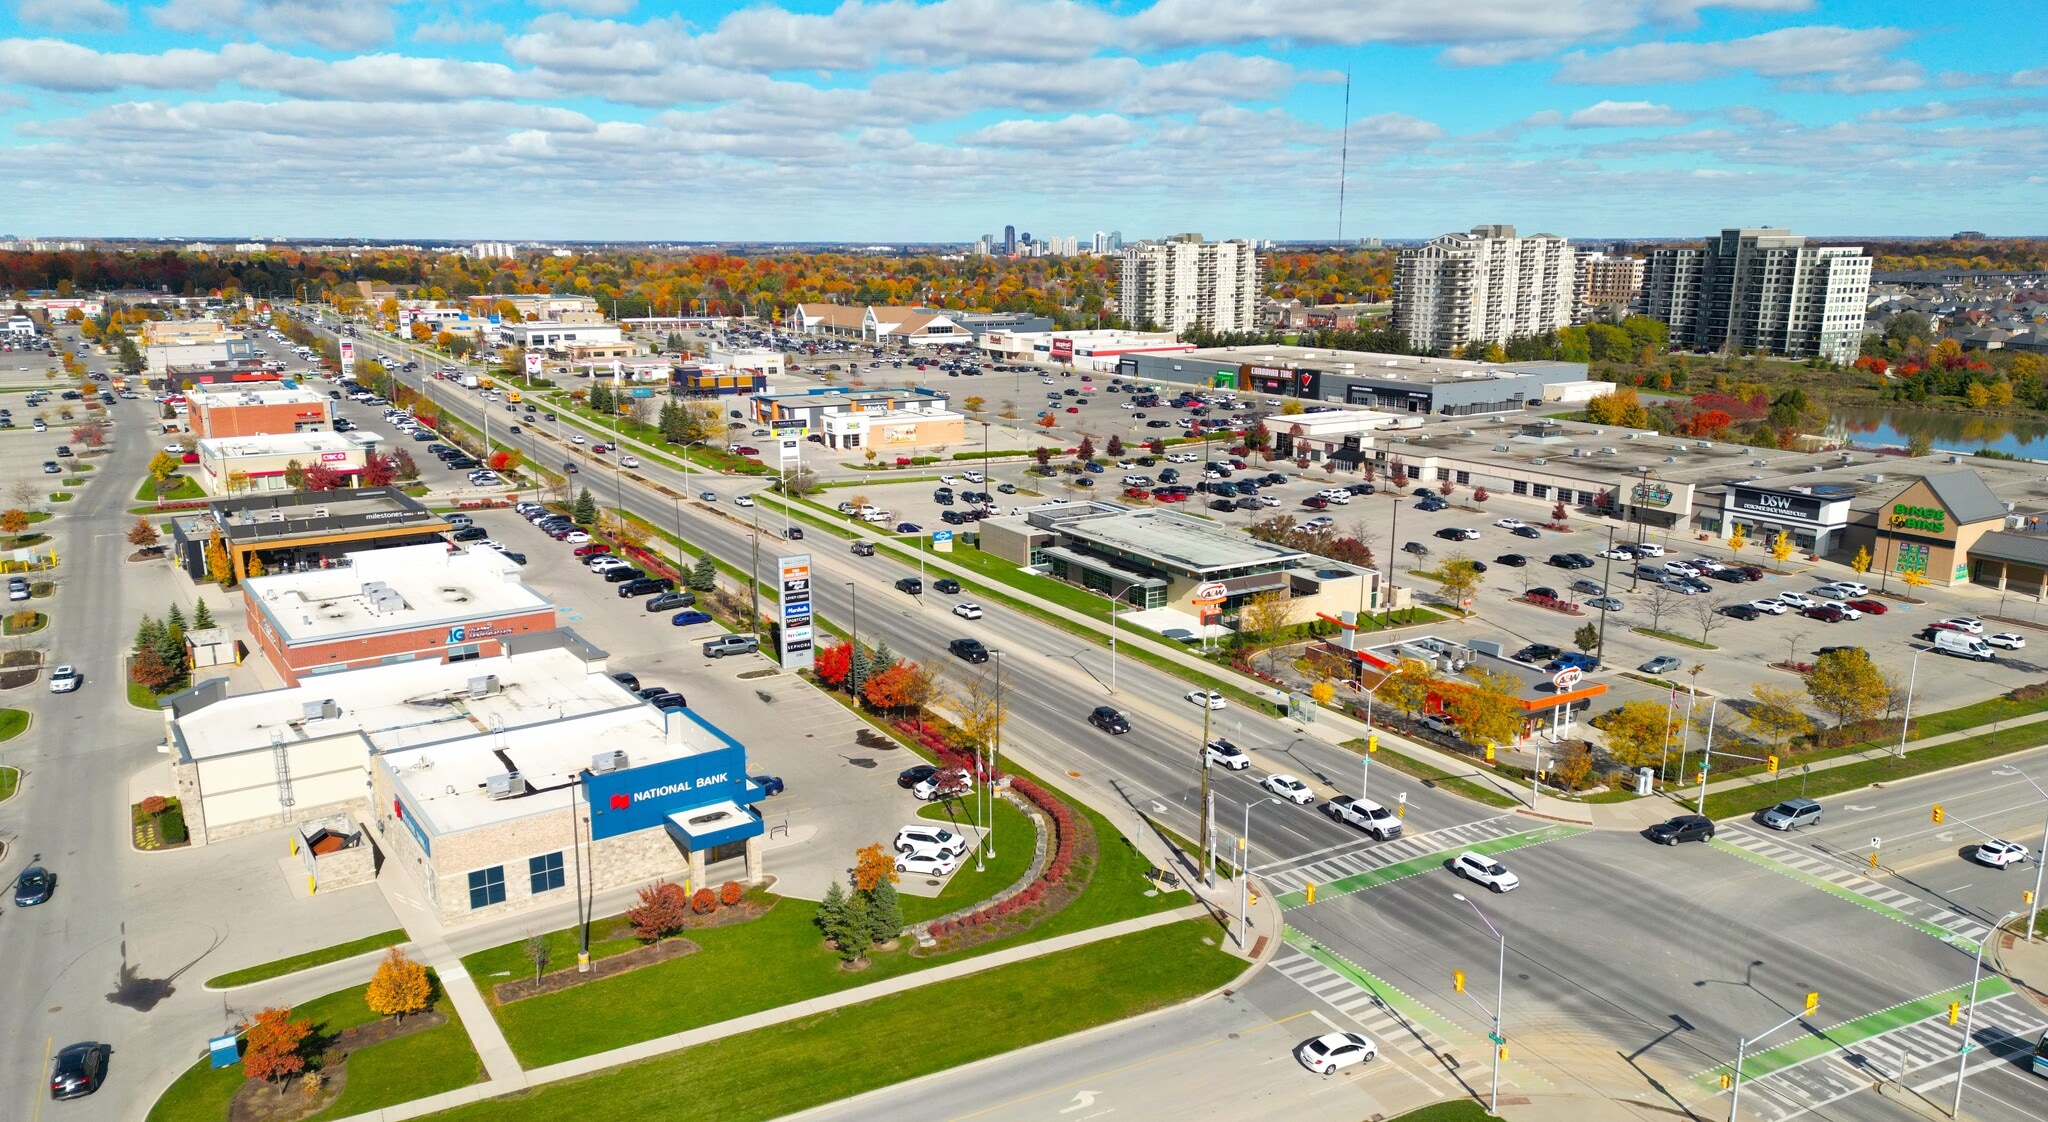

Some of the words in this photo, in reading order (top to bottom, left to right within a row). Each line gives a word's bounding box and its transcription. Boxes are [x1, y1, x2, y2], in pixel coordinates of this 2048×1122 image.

[1760, 494, 1792, 509] DSW
[365, 511, 403, 520] milestones
[1905, 517, 1945, 533] BINS
[787, 605, 808, 614] Marshalls
[449, 628, 466, 642] IG
[787, 642, 811, 651] SEPHORA
[633, 781, 692, 802] NATIONAL
[696, 772, 729, 788] BANK
